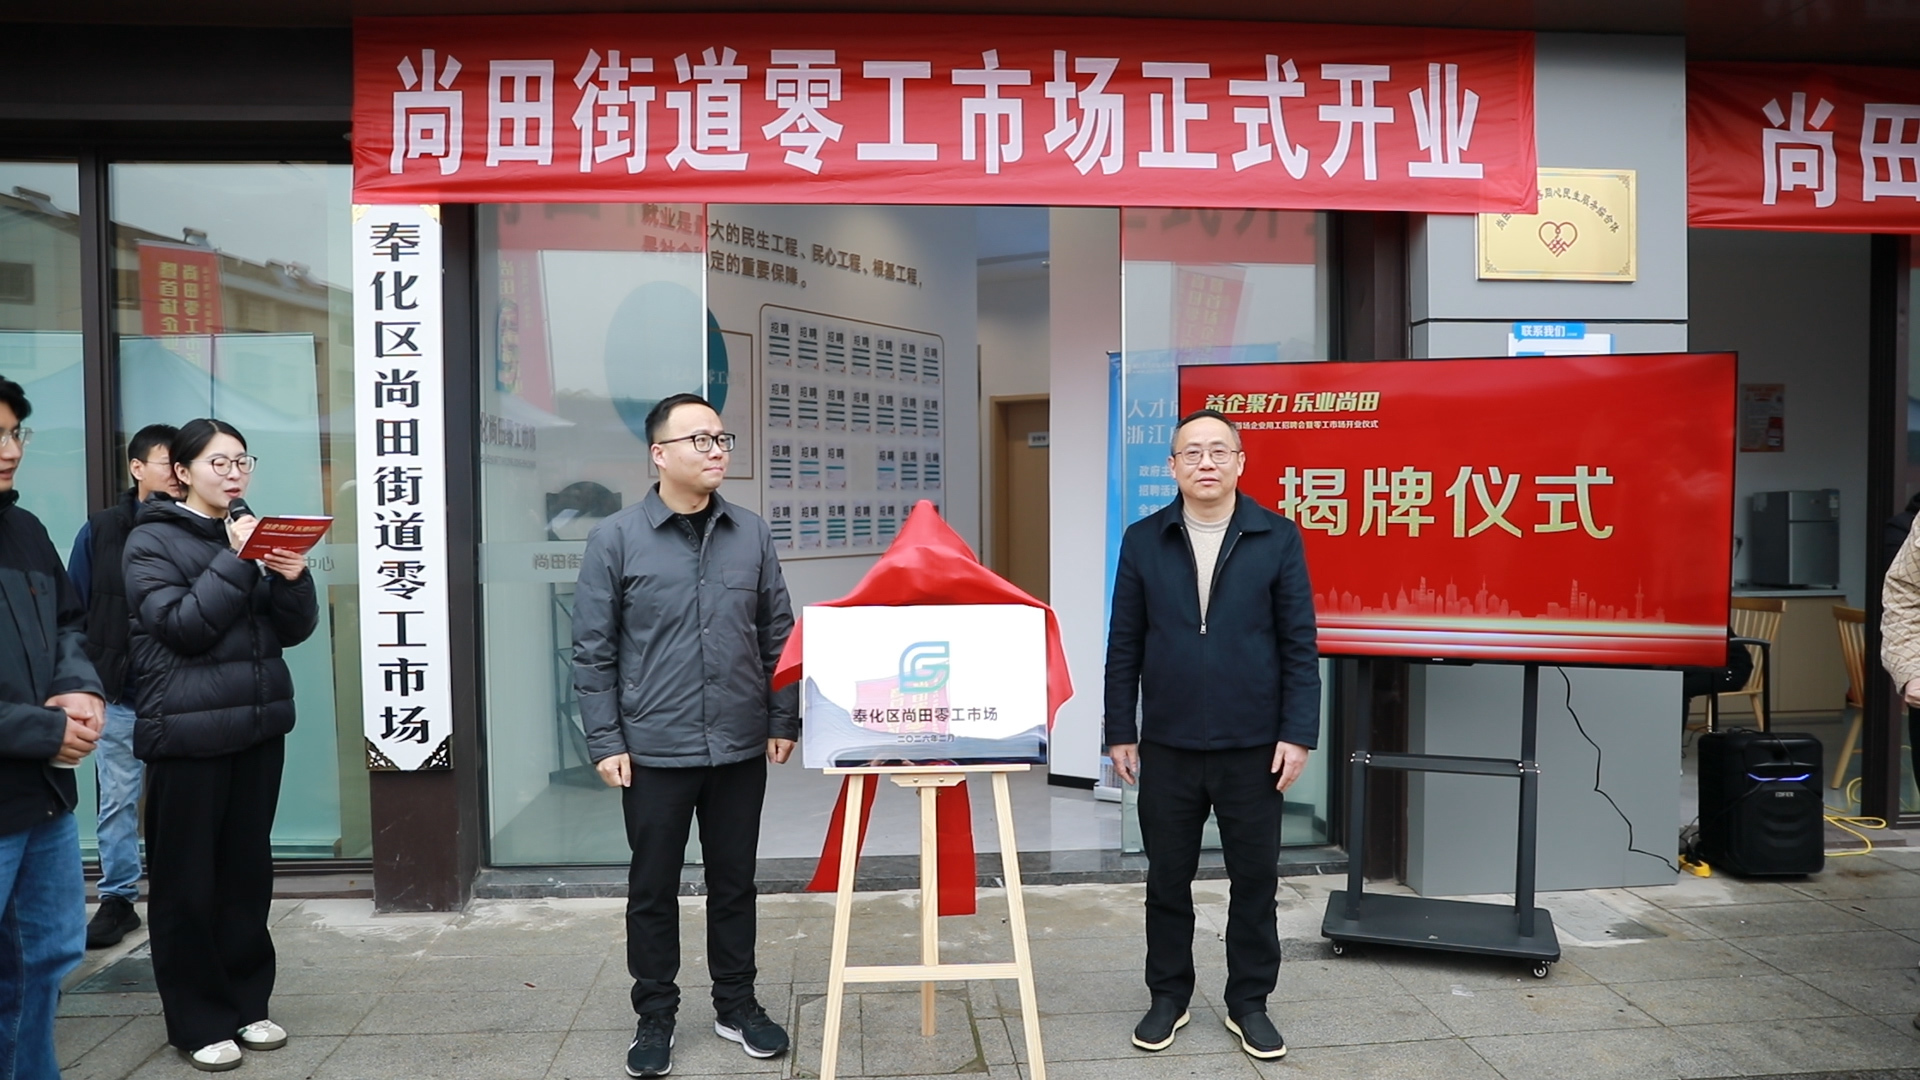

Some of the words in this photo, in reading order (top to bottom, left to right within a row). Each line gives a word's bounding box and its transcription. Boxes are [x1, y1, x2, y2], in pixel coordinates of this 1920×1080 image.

[389, 46, 1484, 180] 尚田街道零工市场正式开业
[1761, 92, 1920, 208] 尚田
[771, 322, 789, 336] 招聘
[800, 327, 817, 340] 招聘
[1521, 325, 1566, 338] 联系我们
[828, 331, 844, 344] 招聘
[854, 335, 869, 348] 招聘
[877, 340, 893, 352] 招聘
[901, 343, 916, 355] 招聘
[924, 347, 938, 358] 招聘
[771, 383, 790, 397] 招聘
[800, 386, 818, 399] 招聘
[828, 389, 845, 402] 招聘
[854, 392, 870, 404] 招聘
[878, 395, 894, 407] 招聘
[902, 397, 917, 409] 招聘
[1205, 393, 1288, 414] 益企聚力
[1292, 391, 1380, 413] 乐业尚田
[924, 400, 938, 411] 招聘
[1235, 420, 1379, 431] 首场企业用工招聘会暨零工市场开业仪式
[1127, 424, 1175, 445] 浙江
[772, 445, 790, 457] 招聘
[801, 446, 819, 459] 招聘
[828, 447, 845, 460] 招聘
[879, 450, 894, 462] 招聘
[902, 451, 917, 463] 招聘
[925, 452, 939, 463] 招聘
[370, 222, 430, 744] 奉化区尚田街道零工市场
[1277, 465, 1614, 539] 揭牌仪式
[772, 505, 791, 518] 招聘
[801, 506, 819, 518] 招聘
[828, 505, 845, 517] 招聘
[854, 505, 871, 517] 招聘
[879, 505, 895, 517] 招聘
[853, 707, 998, 723] 奉化区尚田零工市场
